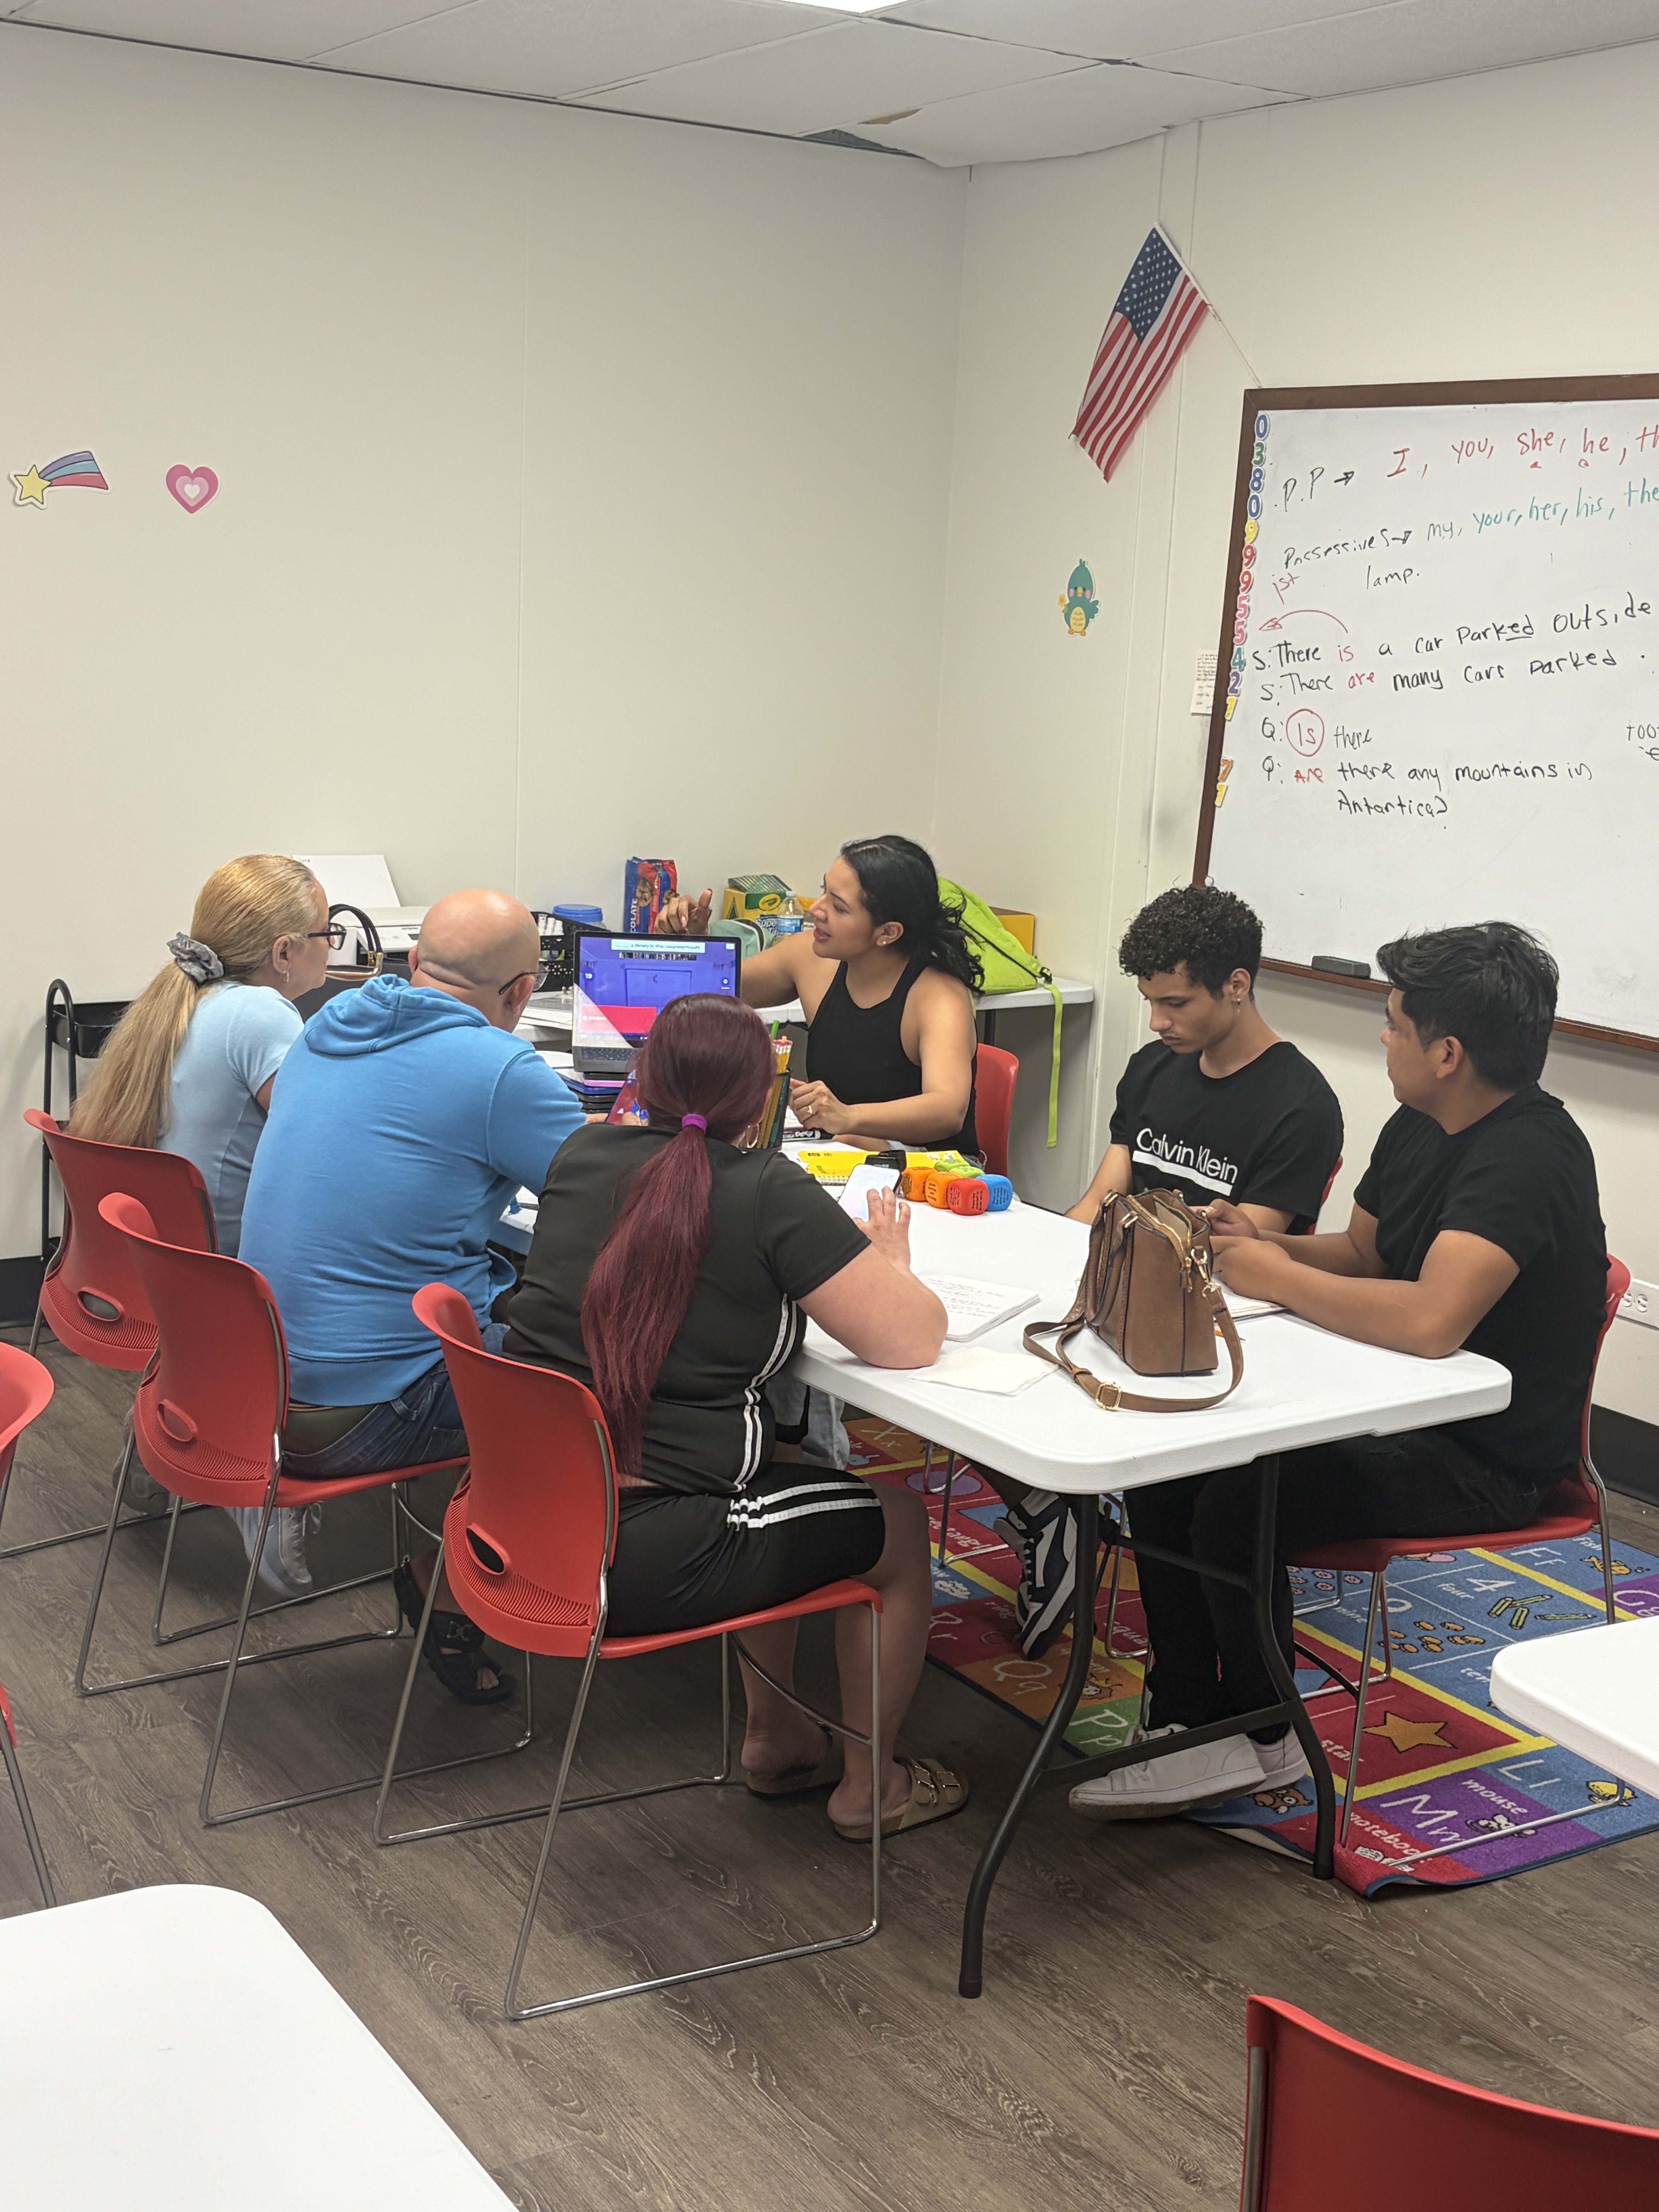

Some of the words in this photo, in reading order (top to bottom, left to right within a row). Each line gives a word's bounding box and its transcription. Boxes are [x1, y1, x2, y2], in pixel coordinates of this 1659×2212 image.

[1275, 640, 1321, 668] There
[1338, 645, 1353, 662] is
[1379, 643, 1393, 655] a
[1280, 673, 1333, 694] There
[1393, 670, 1443, 691] many
[1626, 724, 1659, 741] too
[1408, 768, 1441, 792] any
[1455, 761, 1558, 781] mountains
[1137, 1128, 1194, 1167] Calvin
[1197, 1145, 1238, 1184] Klein
[1466, 1578, 1516, 1592] 4
[1380, 1794, 1458, 1829] M
[1461, 1779, 1528, 1814] mouse
[1350, 1812, 1432, 1863] noteboo
